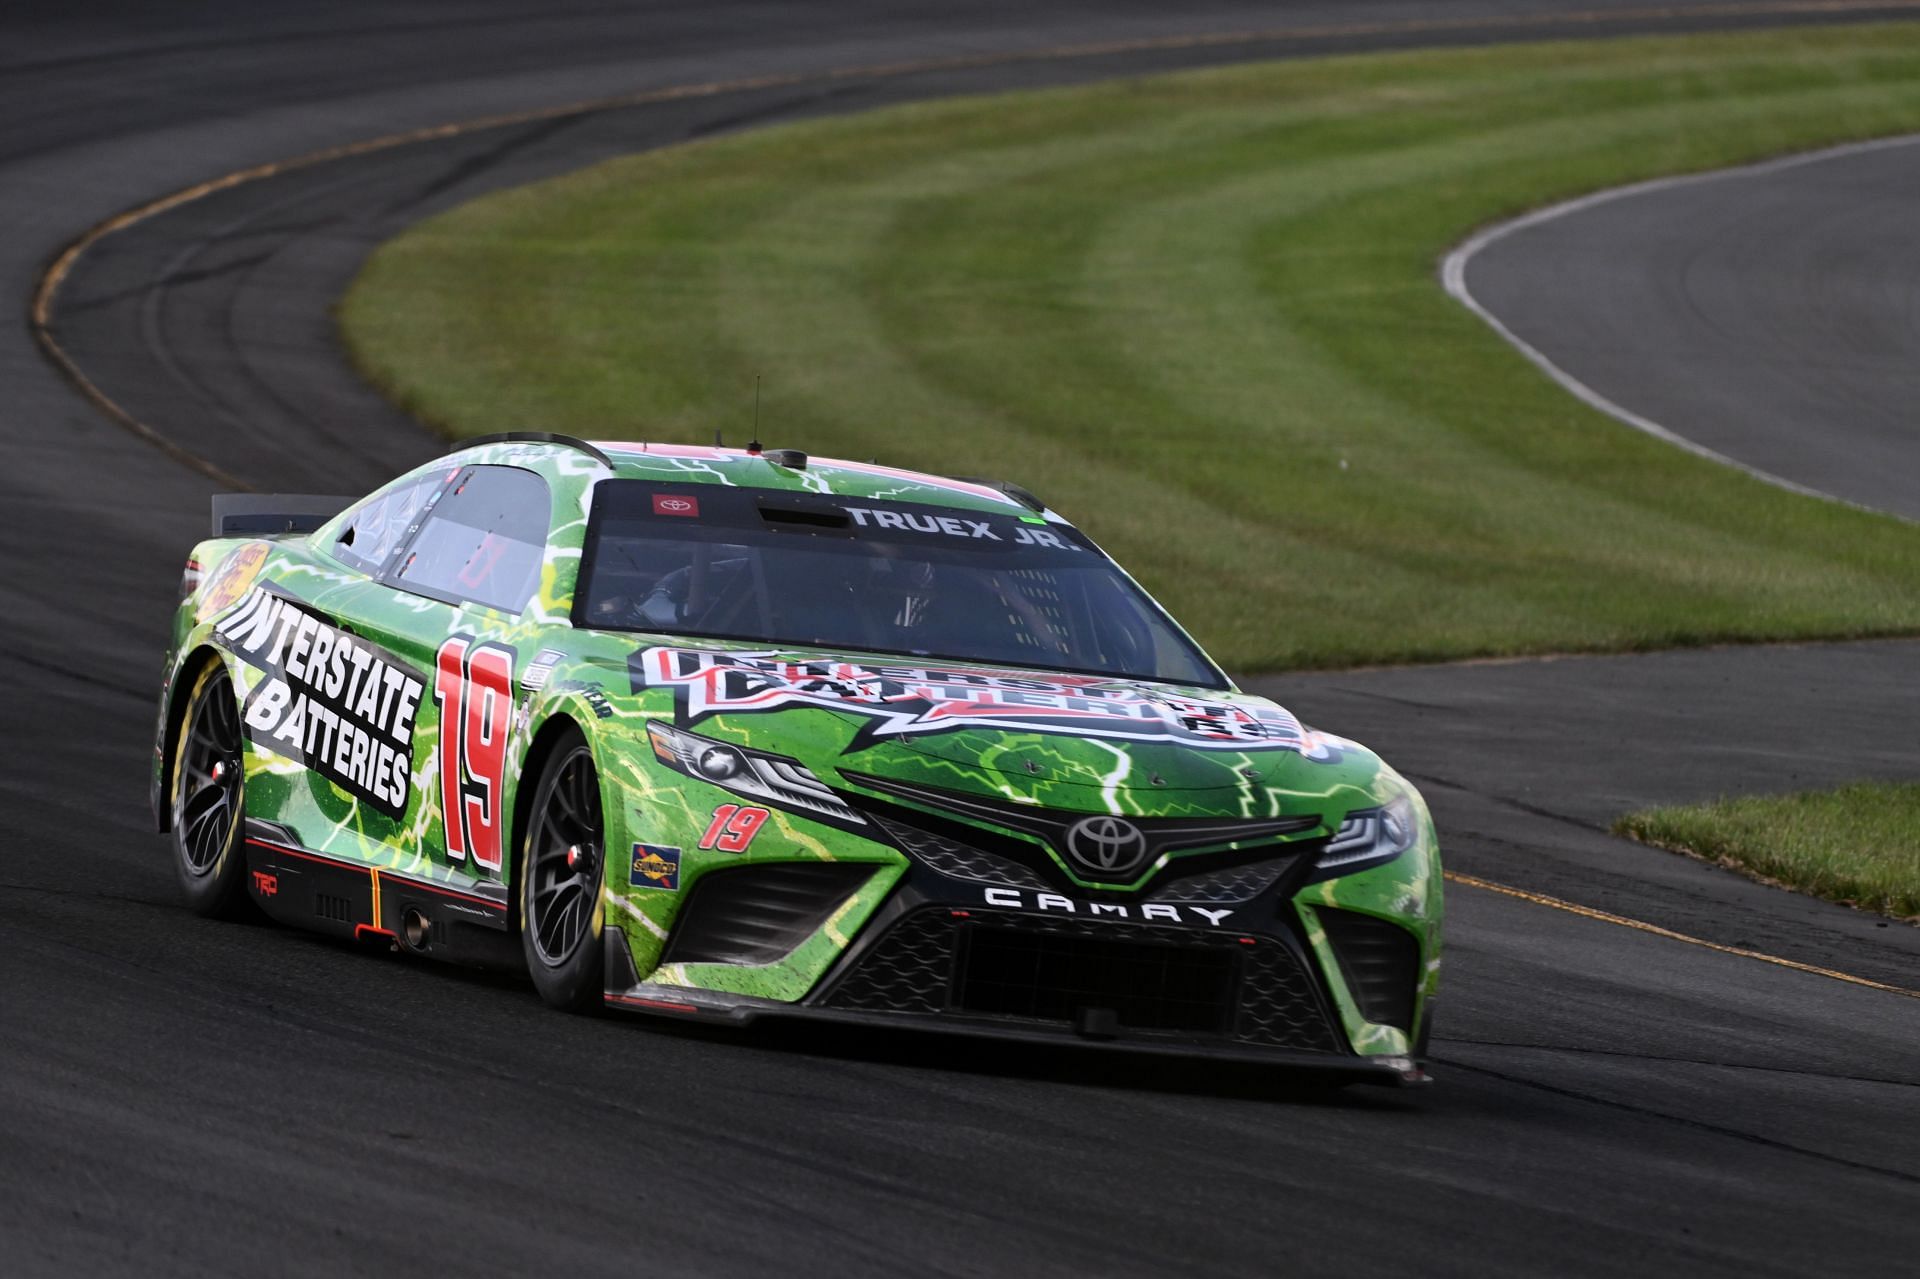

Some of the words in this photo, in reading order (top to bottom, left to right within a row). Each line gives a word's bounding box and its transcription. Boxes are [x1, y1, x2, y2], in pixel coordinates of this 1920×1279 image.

[842, 507, 1002, 541] TRUEX
[1014, 526, 1083, 552] JR.
[217, 587, 422, 744] INTERSTATE
[245, 679, 408, 808] BATTERIES
[435, 637, 514, 872] 19
[697, 804, 770, 853] 19
[252, 871, 278, 897] TRD
[633, 859, 676, 876] SUNOCO
[985, 887, 1234, 926] CAMRY
